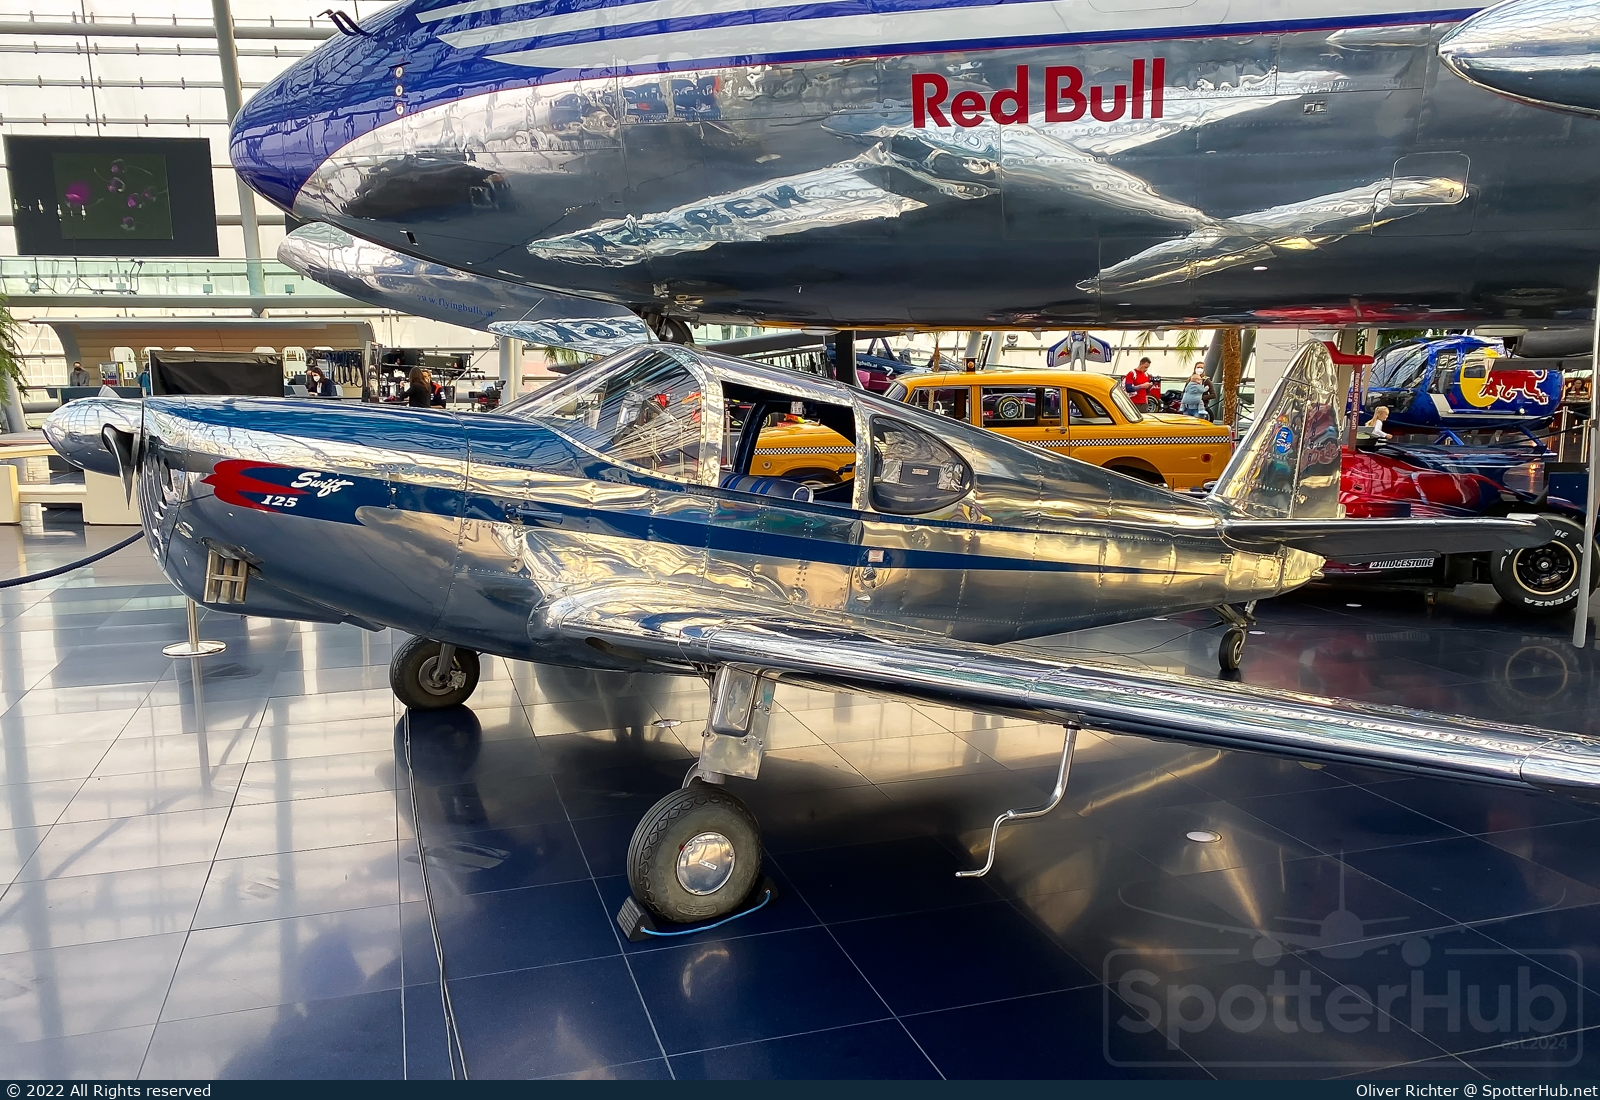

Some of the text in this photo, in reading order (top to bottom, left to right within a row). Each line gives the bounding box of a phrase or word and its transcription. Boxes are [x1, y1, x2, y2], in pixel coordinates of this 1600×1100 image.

[911, 57, 1165, 128] Red Bull
[290, 471, 354, 498] Swift
[260, 494, 298, 507] 125
[1369, 558, 1435, 569] BRIDGESTONE
[1524, 588, 1580, 607] OTENZA
